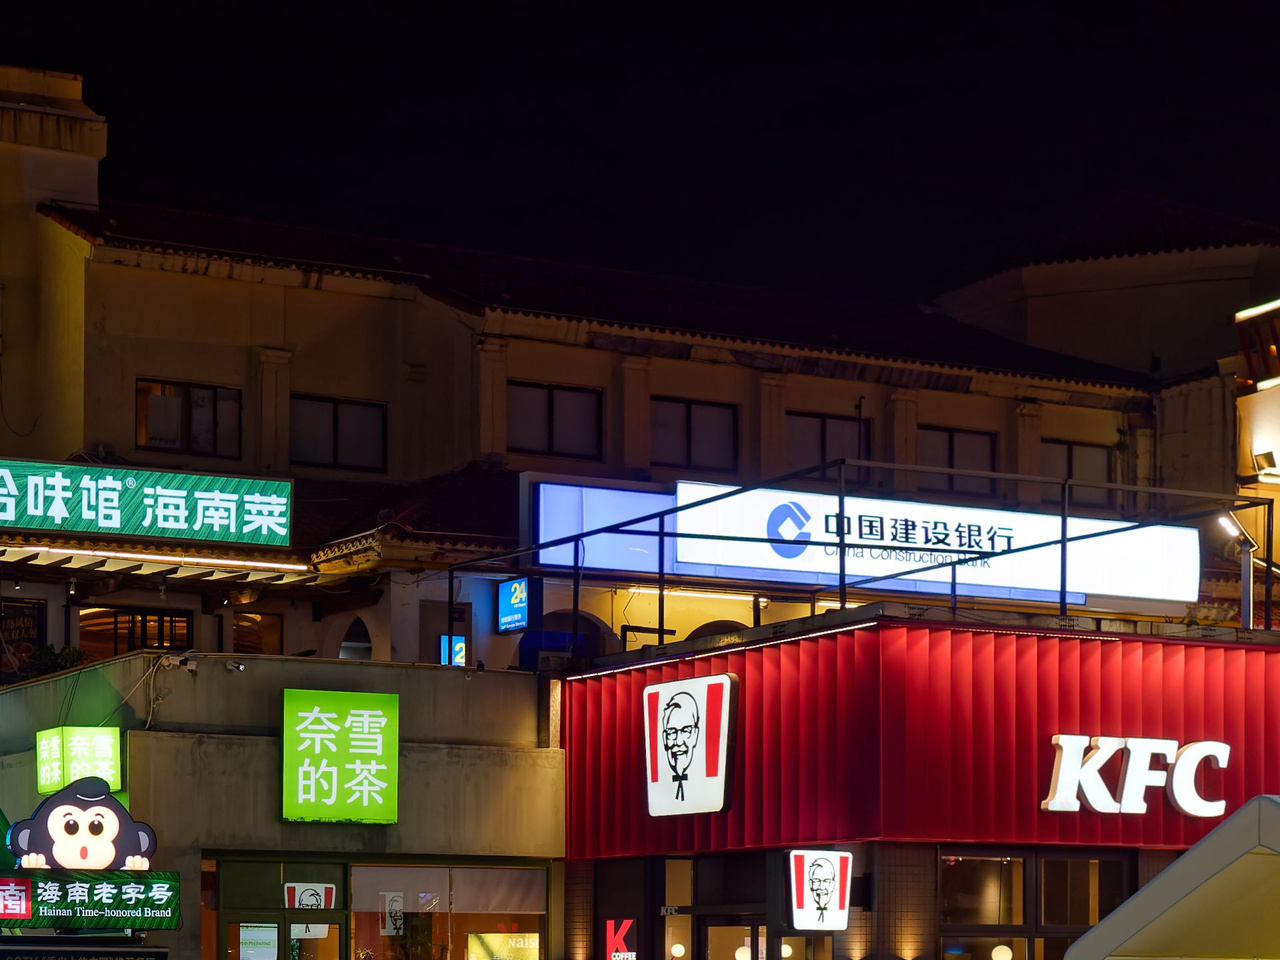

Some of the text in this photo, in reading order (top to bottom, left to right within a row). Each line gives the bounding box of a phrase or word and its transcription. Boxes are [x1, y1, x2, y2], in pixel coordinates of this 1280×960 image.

[142, 486, 288, 536] 海南菜
[824, 513, 1015, 553] 中国建设银行
[869, 547, 953, 565] Construction
[510, 581, 526, 604] 24
[295, 706, 388, 757] 奈雪
[1041, 734, 1231, 818] KFC
[37, 881, 174, 906] 海南老字号
[39, 906, 73, 917] Hainan
[144, 907, 172, 918] Brand
[661, 906, 679, 916] KFC
[611, 951, 636, 960] COFFEE
